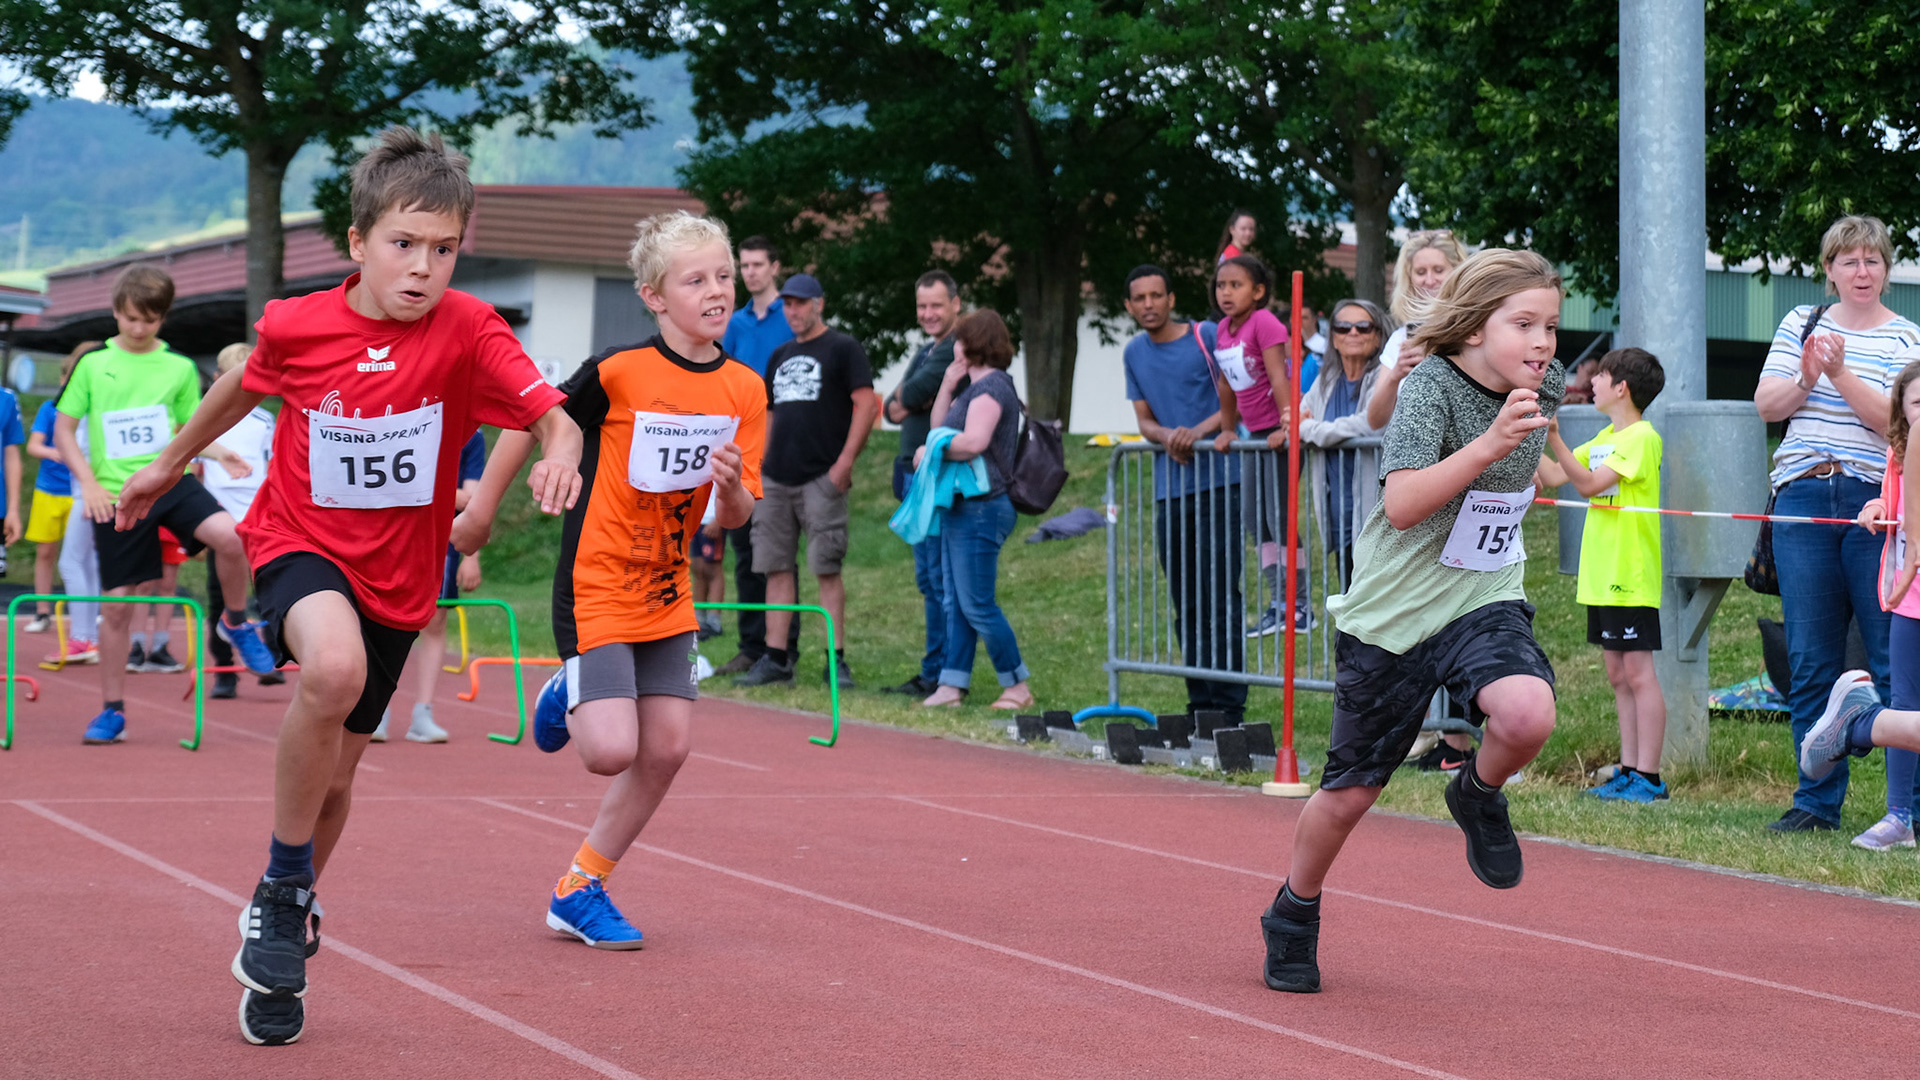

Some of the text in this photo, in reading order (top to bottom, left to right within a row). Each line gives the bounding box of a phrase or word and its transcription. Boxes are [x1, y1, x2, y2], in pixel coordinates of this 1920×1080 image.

[356, 361, 396, 373] erima
[118, 426, 154, 445] 163
[378, 421, 433, 443] SPRINT
[688, 427, 728, 437] SPRINT
[340, 448, 417, 489] 156
[657, 444, 710, 476] 158
